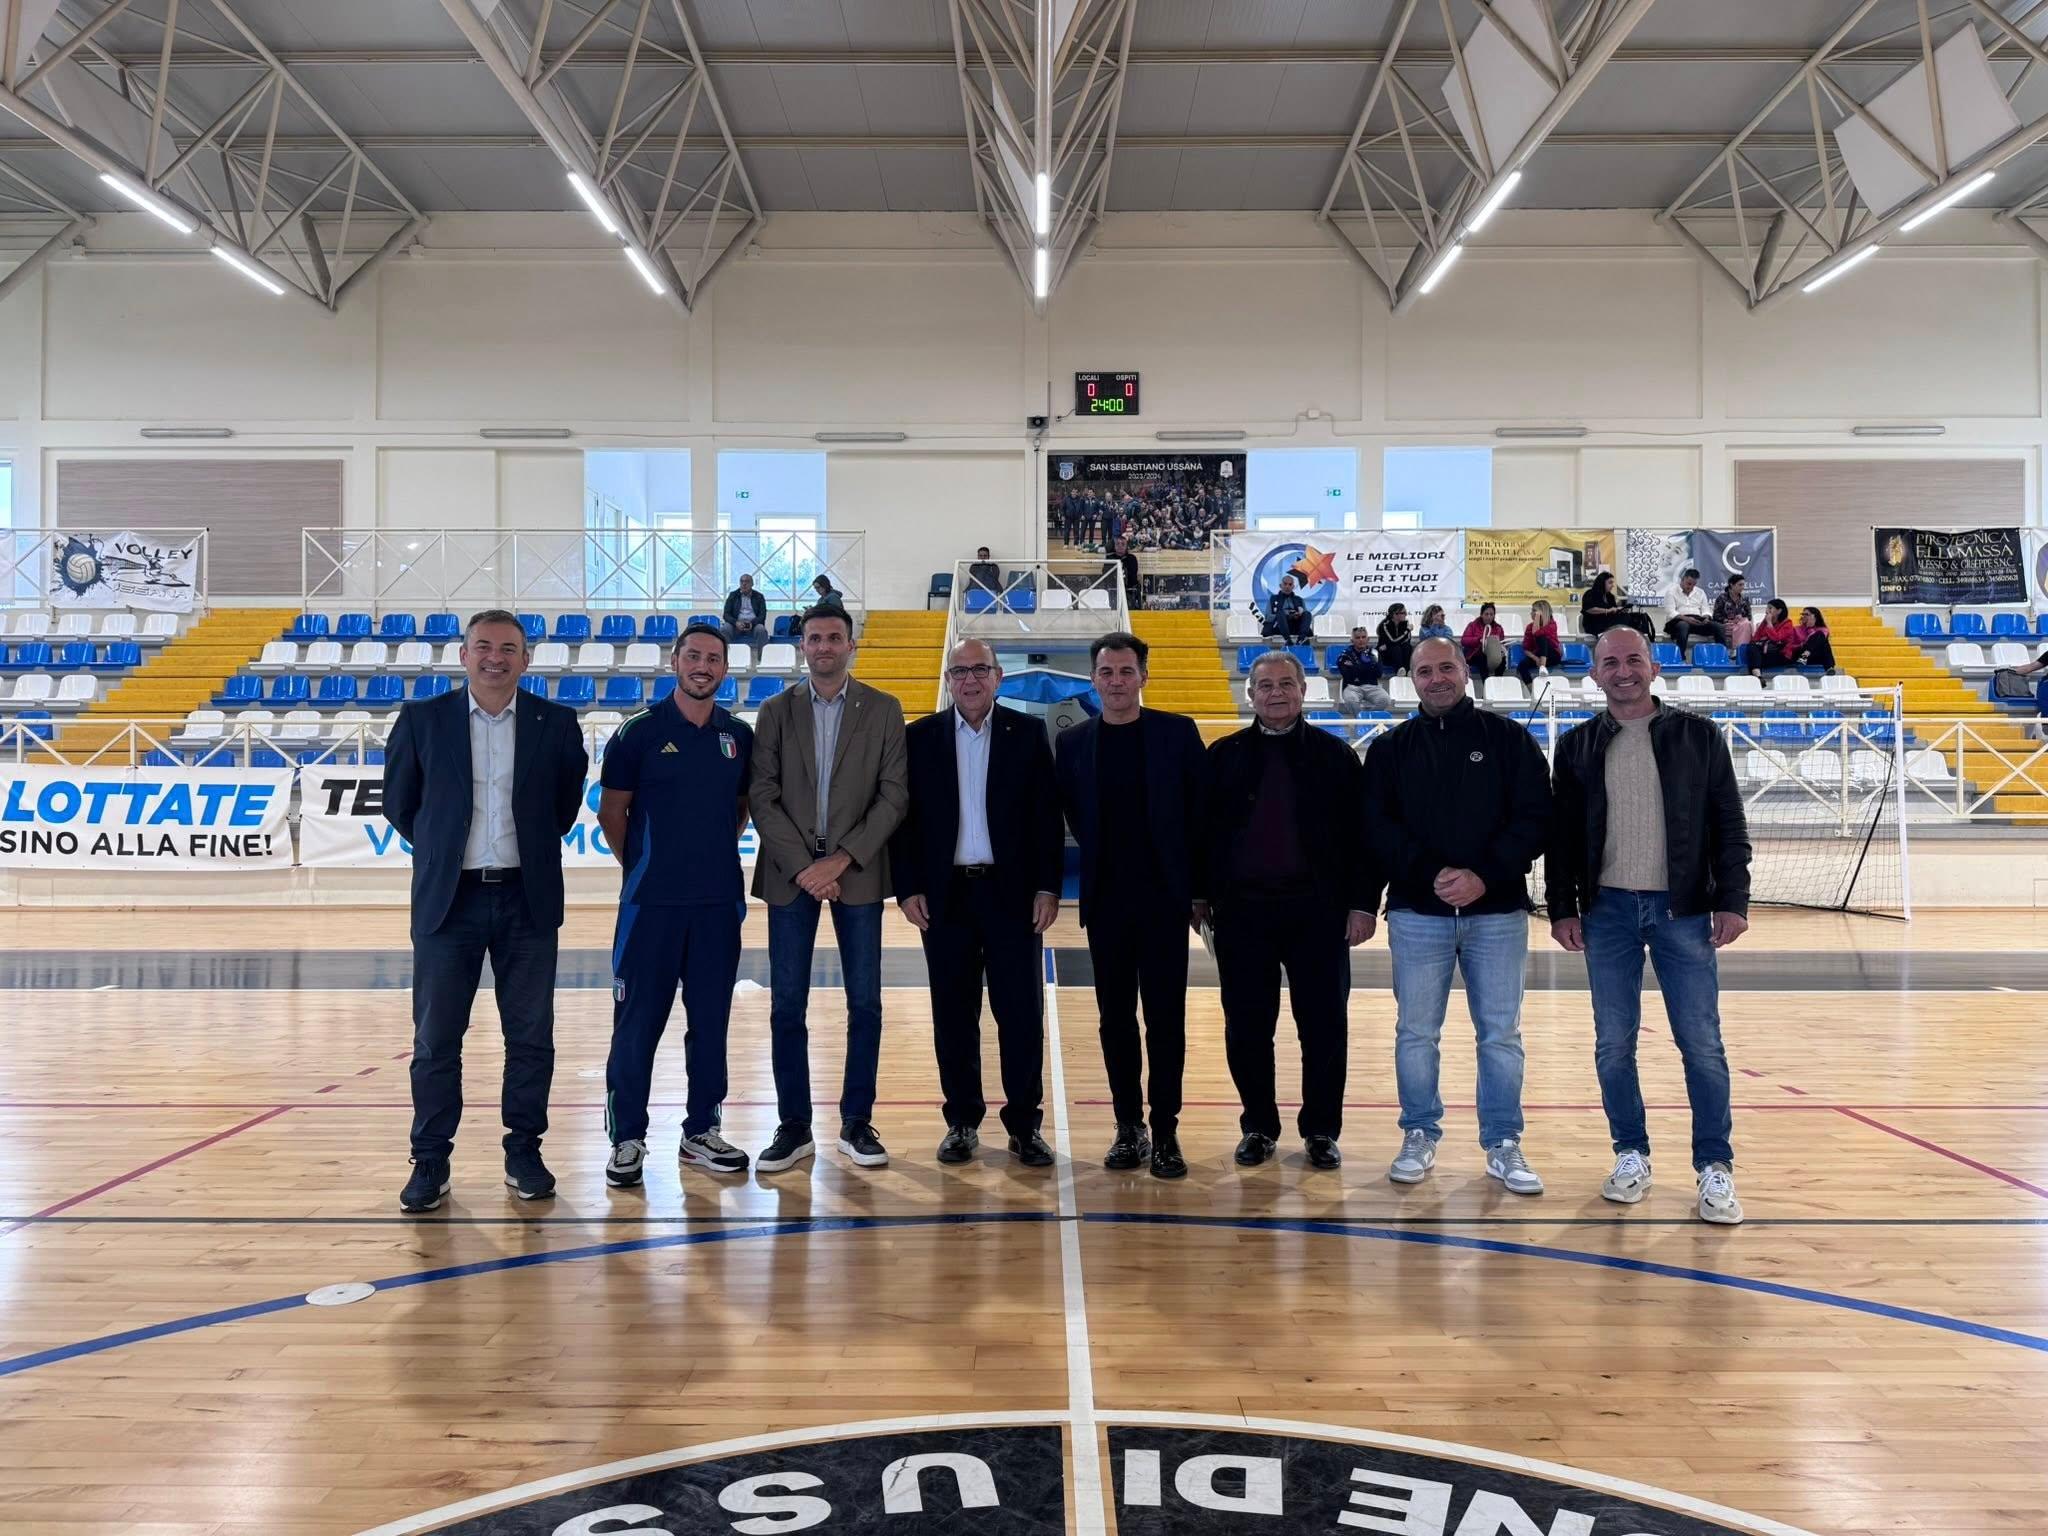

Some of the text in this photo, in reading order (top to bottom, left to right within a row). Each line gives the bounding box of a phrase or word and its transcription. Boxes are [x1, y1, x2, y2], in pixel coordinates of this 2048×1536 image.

[1087, 383, 1133, 396] 0 0
[1091, 398, 1124, 412] 24:00
[1090, 463, 1203, 471] SAN SEBASTIANO USSANA
[1469, 540, 1483, 548] PER
[1494, 540, 1509, 548] TUO
[1916, 532, 2010, 546] PIROTECNICA
[115, 542, 193, 560] VOLLEY
[1346, 551, 1445, 561] LE MIGLIORI
[1491, 548, 1502, 556] LA
[1957, 544, 2013, 557] MASSA
[1375, 562, 1422, 571] LENTI
[1353, 573, 1439, 582] PER I TUOI
[1359, 584, 1437, 593] OCCHIALI
[2, 780, 276, 826] LOTTATE
[0, 830, 272, 857] SINO ALLA FINE!
[1124, 1449, 1283, 1515] DI
